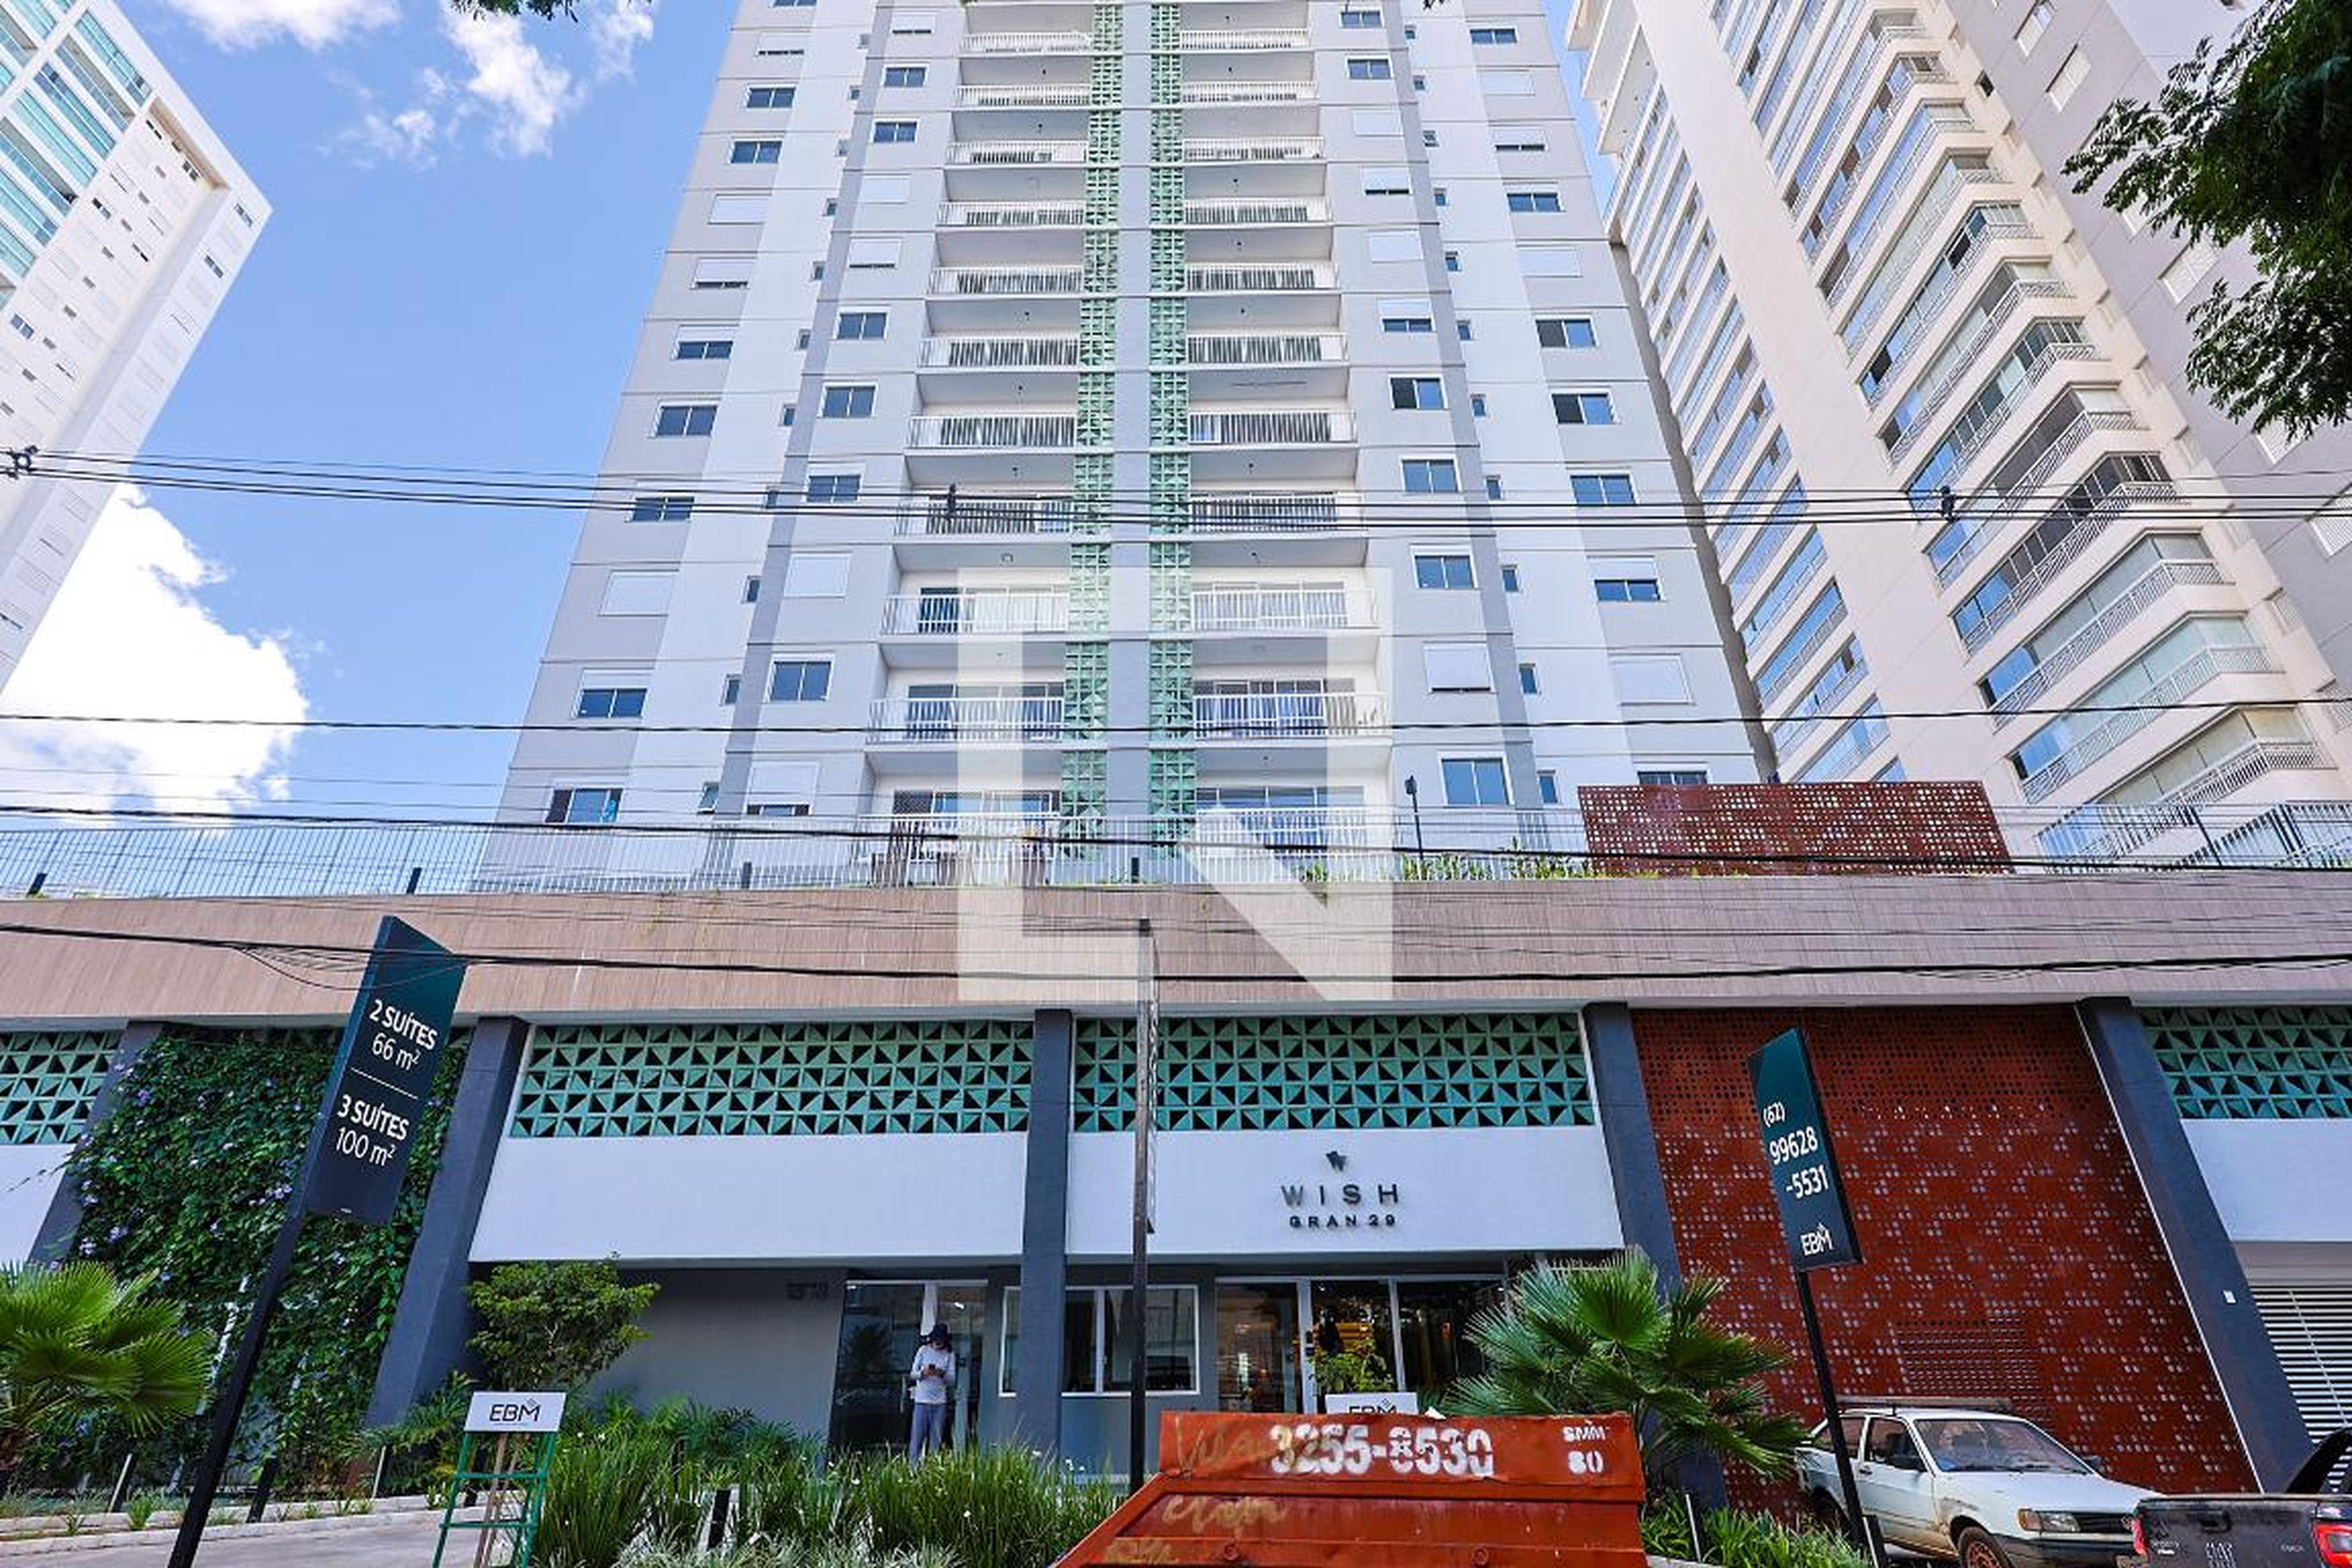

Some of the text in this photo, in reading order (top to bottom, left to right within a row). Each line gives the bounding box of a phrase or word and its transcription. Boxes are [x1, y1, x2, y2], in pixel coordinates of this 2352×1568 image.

[369, 999, 438, 1050] 2 SUÍTES
[372, 1033, 396, 1060] 66
[337, 1094, 409, 1140] 3 SUÍTES
[336, 1127, 369, 1158] 100
[1770, 1126, 1818, 1165] 99628
[1281, 1183, 1399, 1207] WISH
[1786, 1164, 1829, 1199] -5531
[1800, 1227, 1833, 1256] EBM
[489, 1404, 540, 1422] EBM
[1270, 1423, 1495, 1477] 3255-8530
[1567, 1450, 1604, 1474] 80
